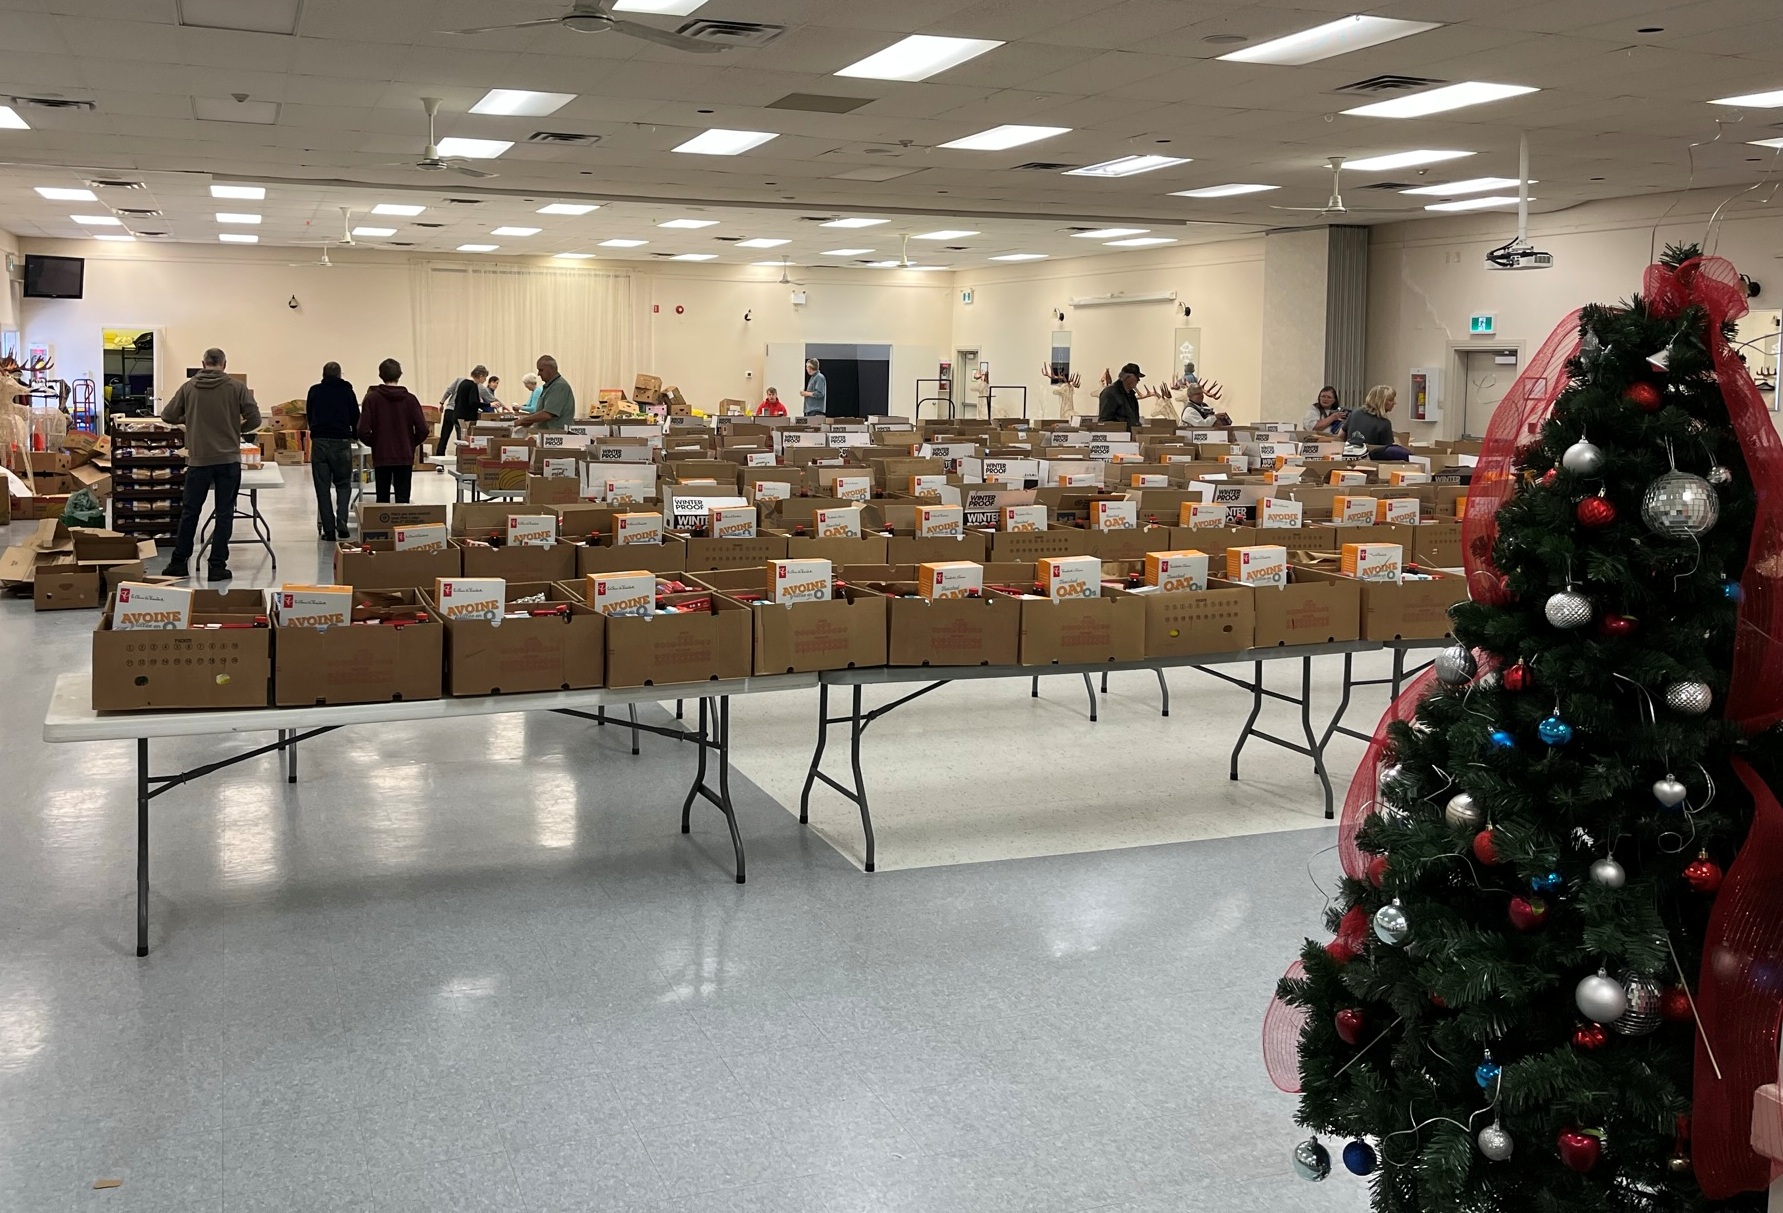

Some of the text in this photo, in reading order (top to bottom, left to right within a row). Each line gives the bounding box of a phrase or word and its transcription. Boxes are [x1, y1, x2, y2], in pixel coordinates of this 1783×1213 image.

[678, 516, 709, 525] WINTE
[967, 513, 999, 522] WINTE
[1104, 517, 1127, 527] OAT
[719, 522, 752, 535] AVOINE
[824, 525, 848, 537] OAT
[926, 521, 959, 534] AVOINE
[513, 530, 551, 542] AVOINE
[623, 530, 658, 543] AVOINE
[1246, 564, 1282, 581] AVOINE
[1362, 562, 1398, 577] AVOINE
[782, 580, 827, 597] AVOINE
[1056, 581, 1086, 597] OAT
[1164, 576, 1193, 592] OAT
[447, 600, 499, 617] AVOINE
[602, 594, 650, 614] AVOINE
[121, 611, 181, 624] AVOINE
[288, 613, 344, 627] AVOINE
